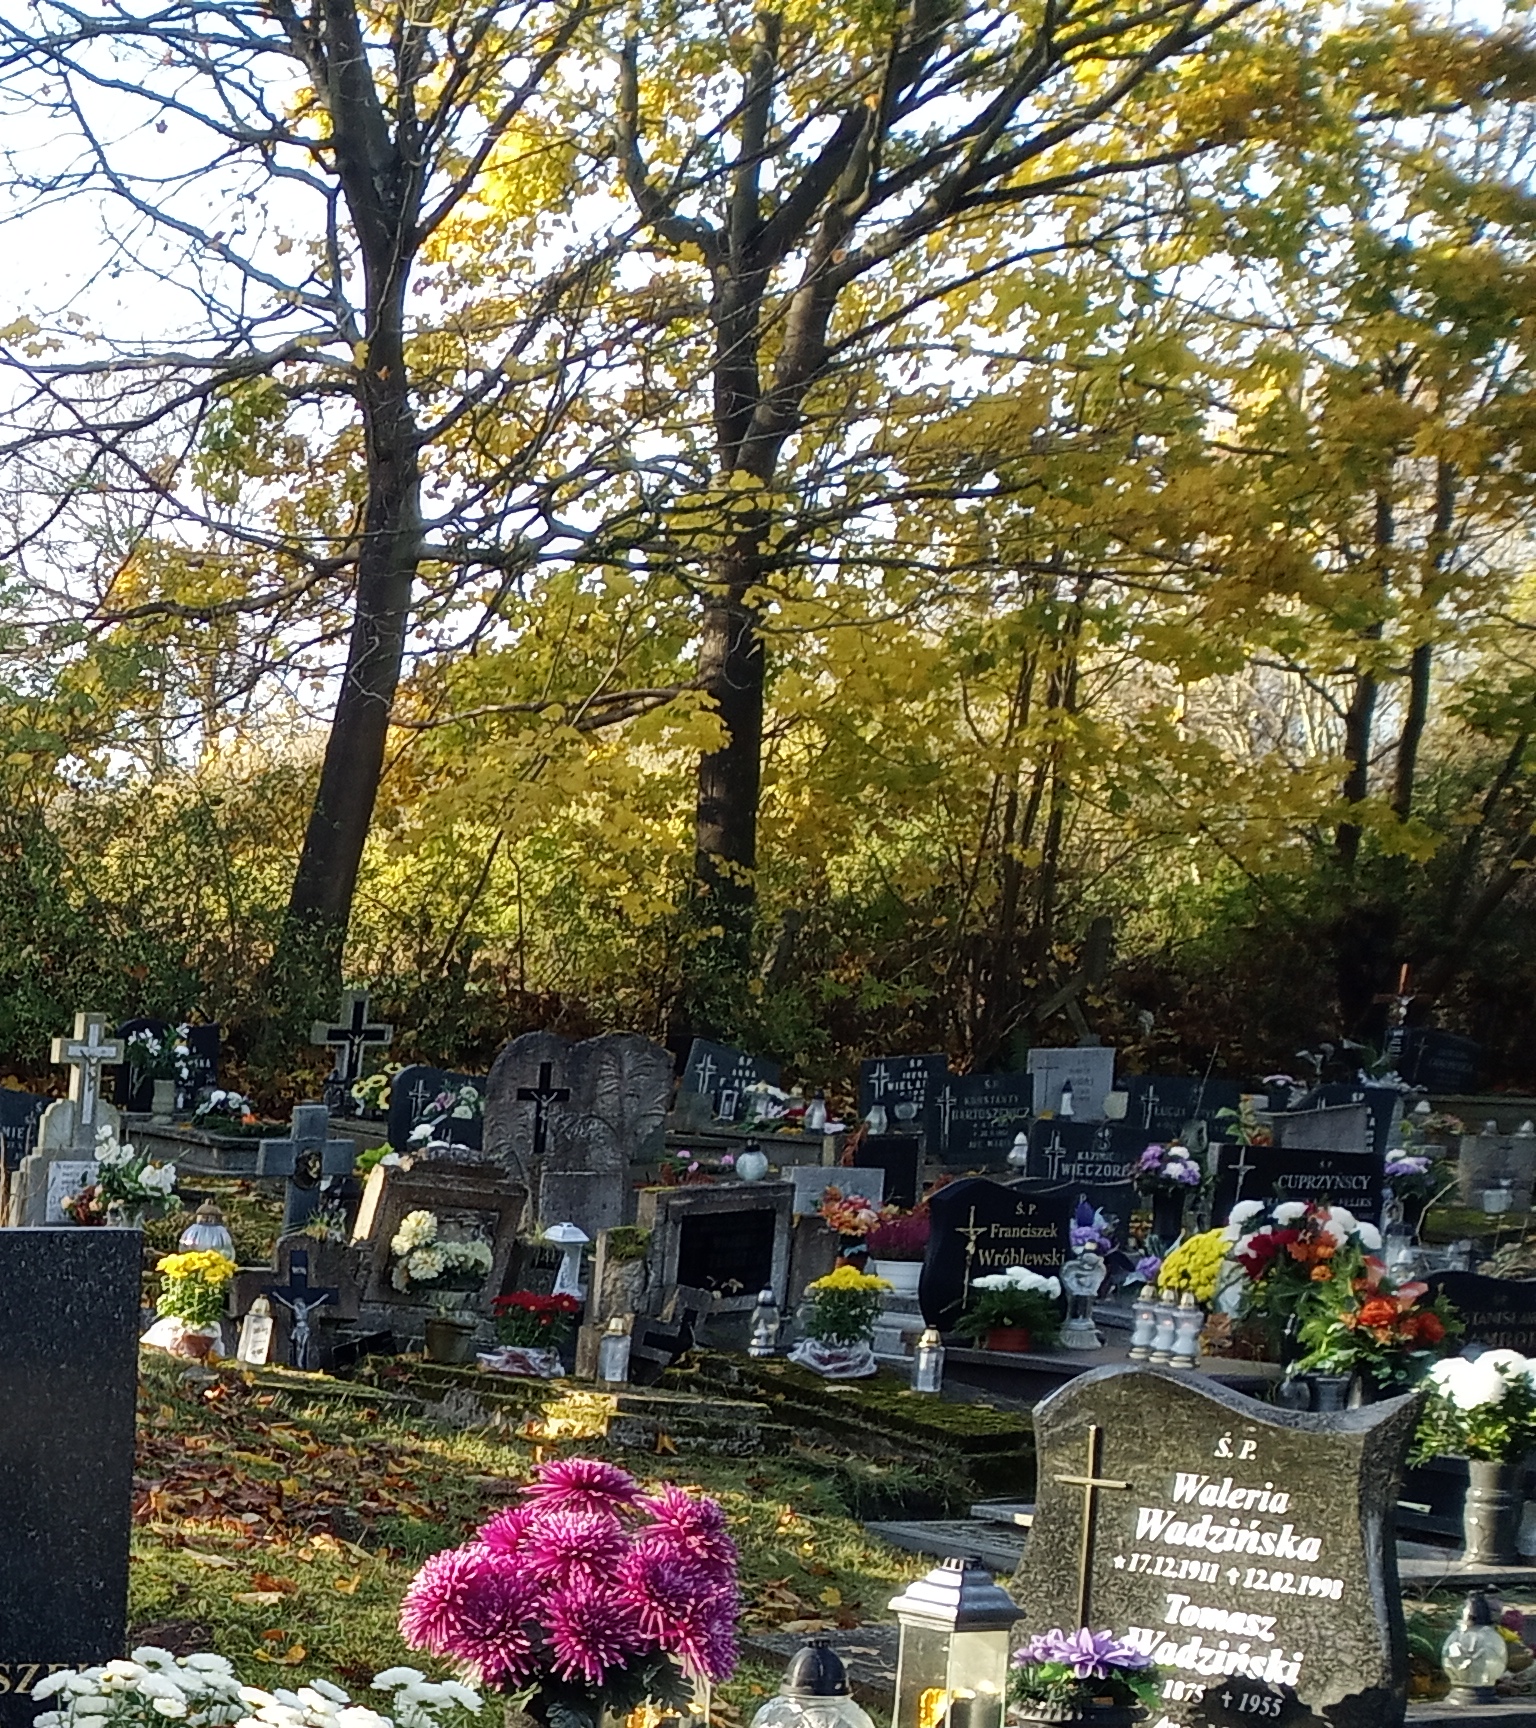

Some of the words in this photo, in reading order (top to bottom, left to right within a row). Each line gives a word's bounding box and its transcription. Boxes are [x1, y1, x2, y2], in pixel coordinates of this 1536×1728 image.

[1278, 1172, 1371, 1190] CUPRZYŃSCY
[990, 1223, 1058, 1238] Franciszek
[978, 1249, 1066, 1267] Wróblewski
[1173, 1472, 1290, 1515] Waleria
[1135, 1506, 1322, 1562] Wadzińska
[1164, 1593, 1277, 1642] Tomasz
[1127, 1627, 1304, 1687] Wadziński
[1162, 1680, 1207, 1703] 1875
[1238, 1693, 1283, 1717] 1955
